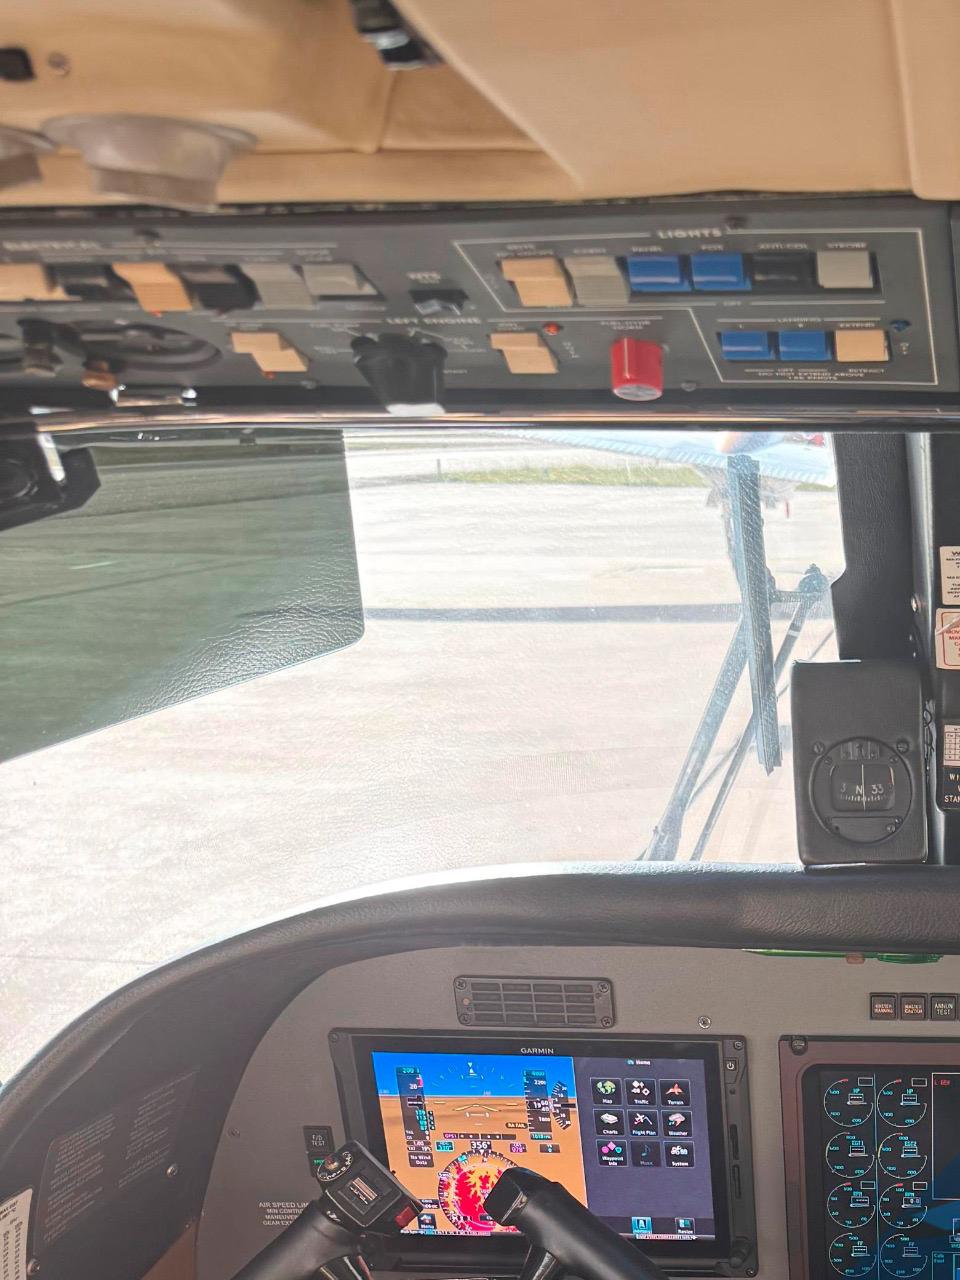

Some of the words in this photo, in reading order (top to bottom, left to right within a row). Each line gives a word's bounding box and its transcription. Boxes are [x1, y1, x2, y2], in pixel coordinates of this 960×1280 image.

[658, 227, 721, 239] LIGHTS
[856, 785, 862, 794] N
[871, 784, 884, 794] 33
